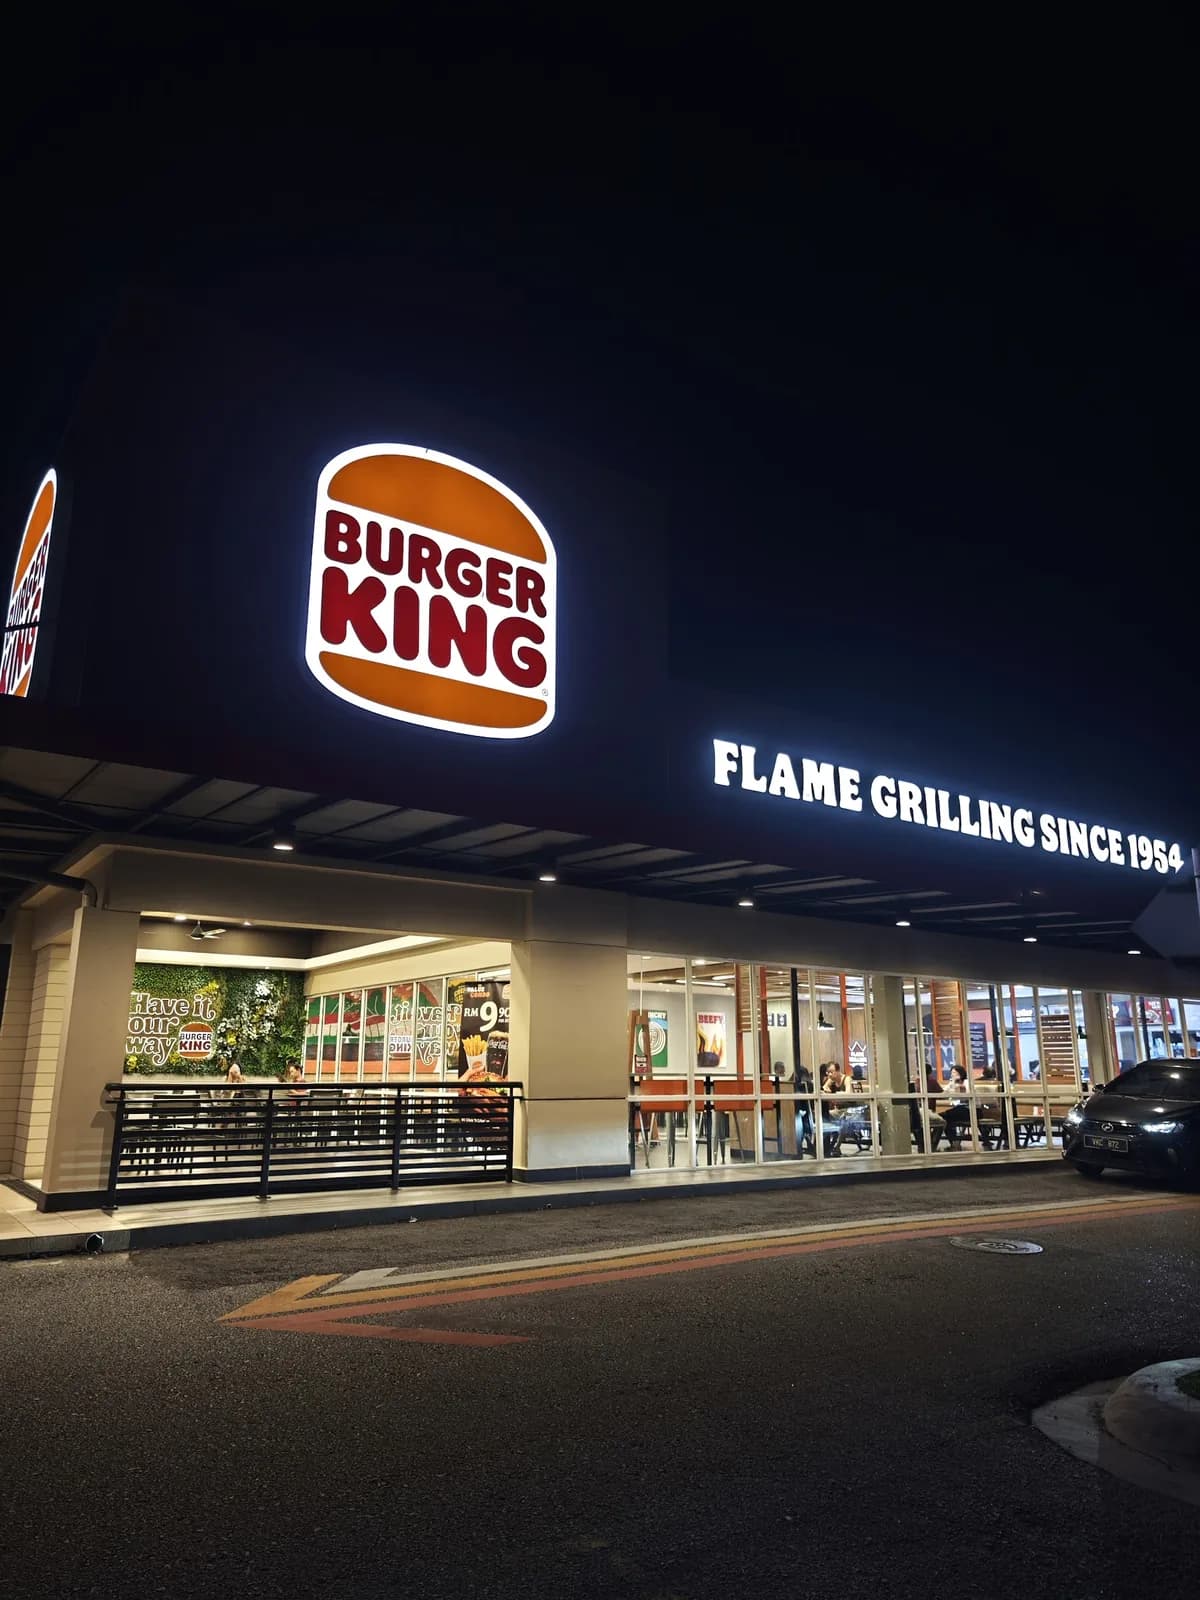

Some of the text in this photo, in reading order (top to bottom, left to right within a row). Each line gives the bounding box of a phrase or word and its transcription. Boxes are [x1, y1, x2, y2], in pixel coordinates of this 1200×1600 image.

[324, 510, 547, 618] BURGER
[320, 566, 548, 689] KING
[713, 738, 1184, 874] FLAME GRILLING SINCE 1954
[129, 992, 216, 1021] Have it
[464, 1008, 479, 1017] RM
[480, 1001, 498, 1032] 9
[698, 1014, 724, 1024] BEEFY
[128, 1016, 180, 1035] our
[179, 1033, 212, 1041] BURGER
[126, 1036, 177, 1066] way
[180, 1041, 211, 1050] KING
